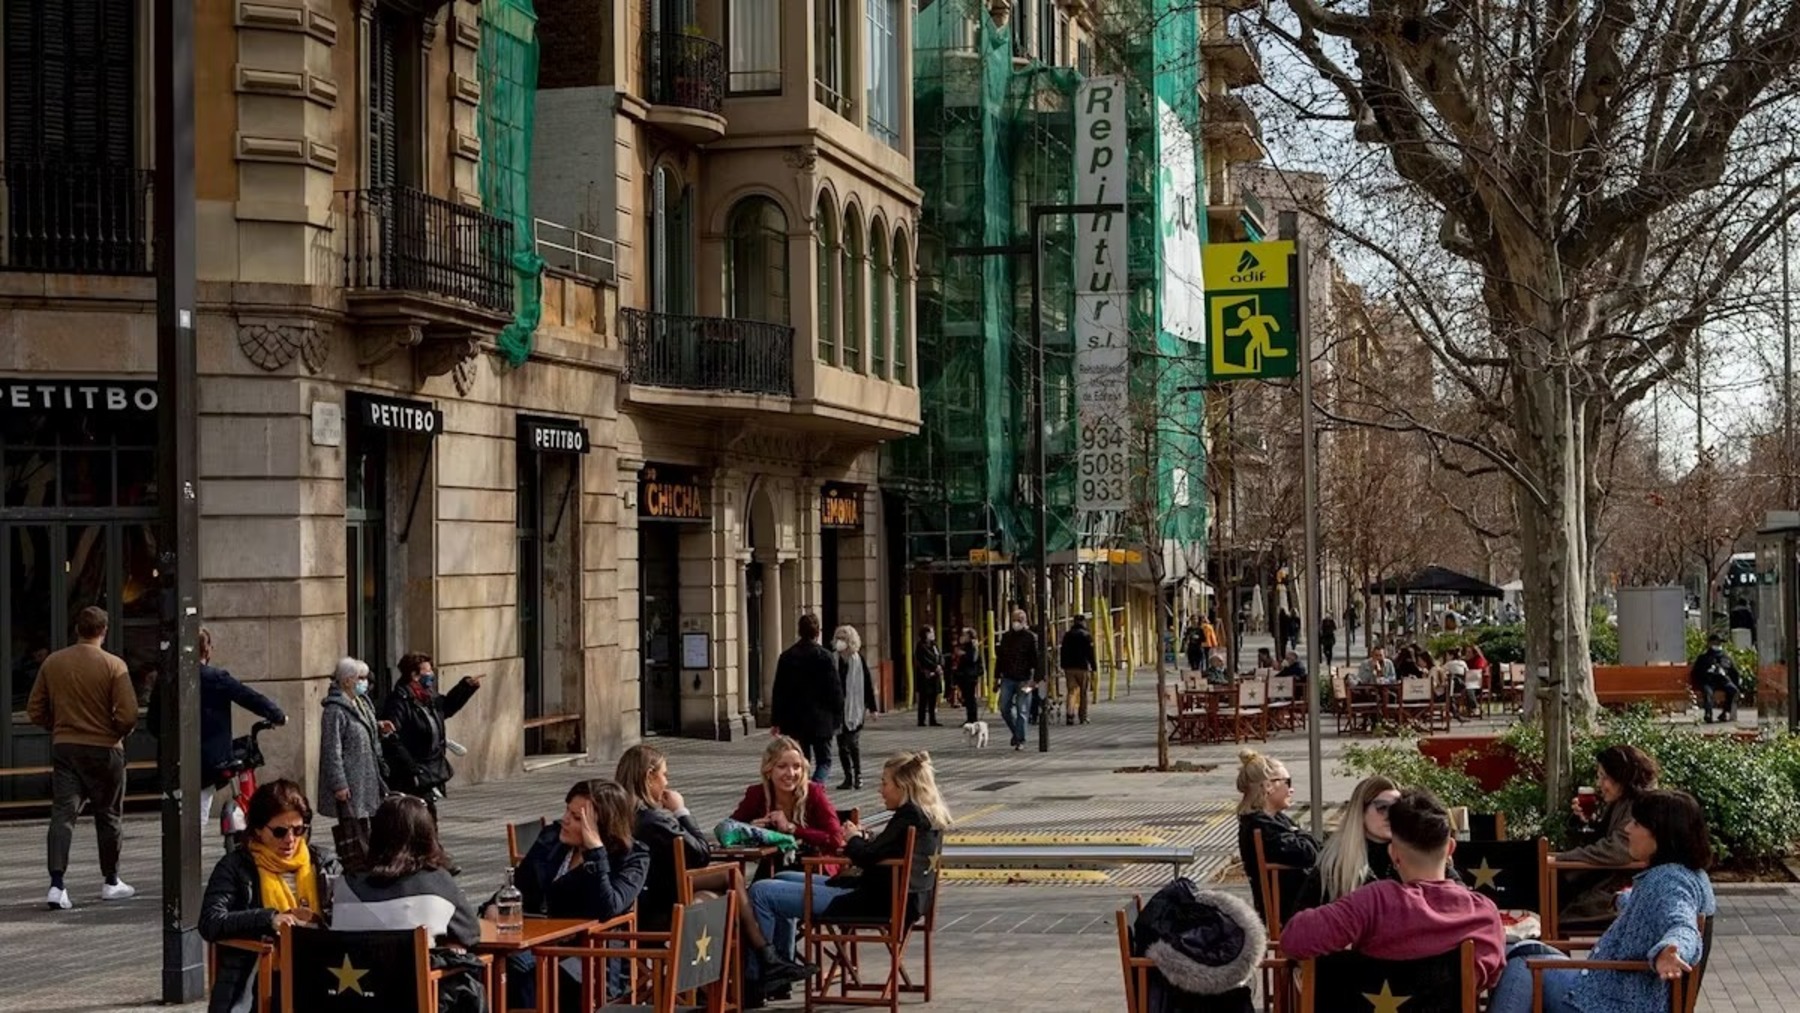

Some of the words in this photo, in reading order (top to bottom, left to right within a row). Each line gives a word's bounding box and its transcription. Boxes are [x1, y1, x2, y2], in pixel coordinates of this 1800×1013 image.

[1230, 271, 1267, 283] adif
[0, 385, 159, 411] ETITBO
[371, 403, 434, 431] PETITBO
[535, 428, 583, 449] PETITBO
[1082, 426, 1122, 449] 934
[1082, 453, 1123, 475] 508
[1082, 479, 1123, 501] 933
